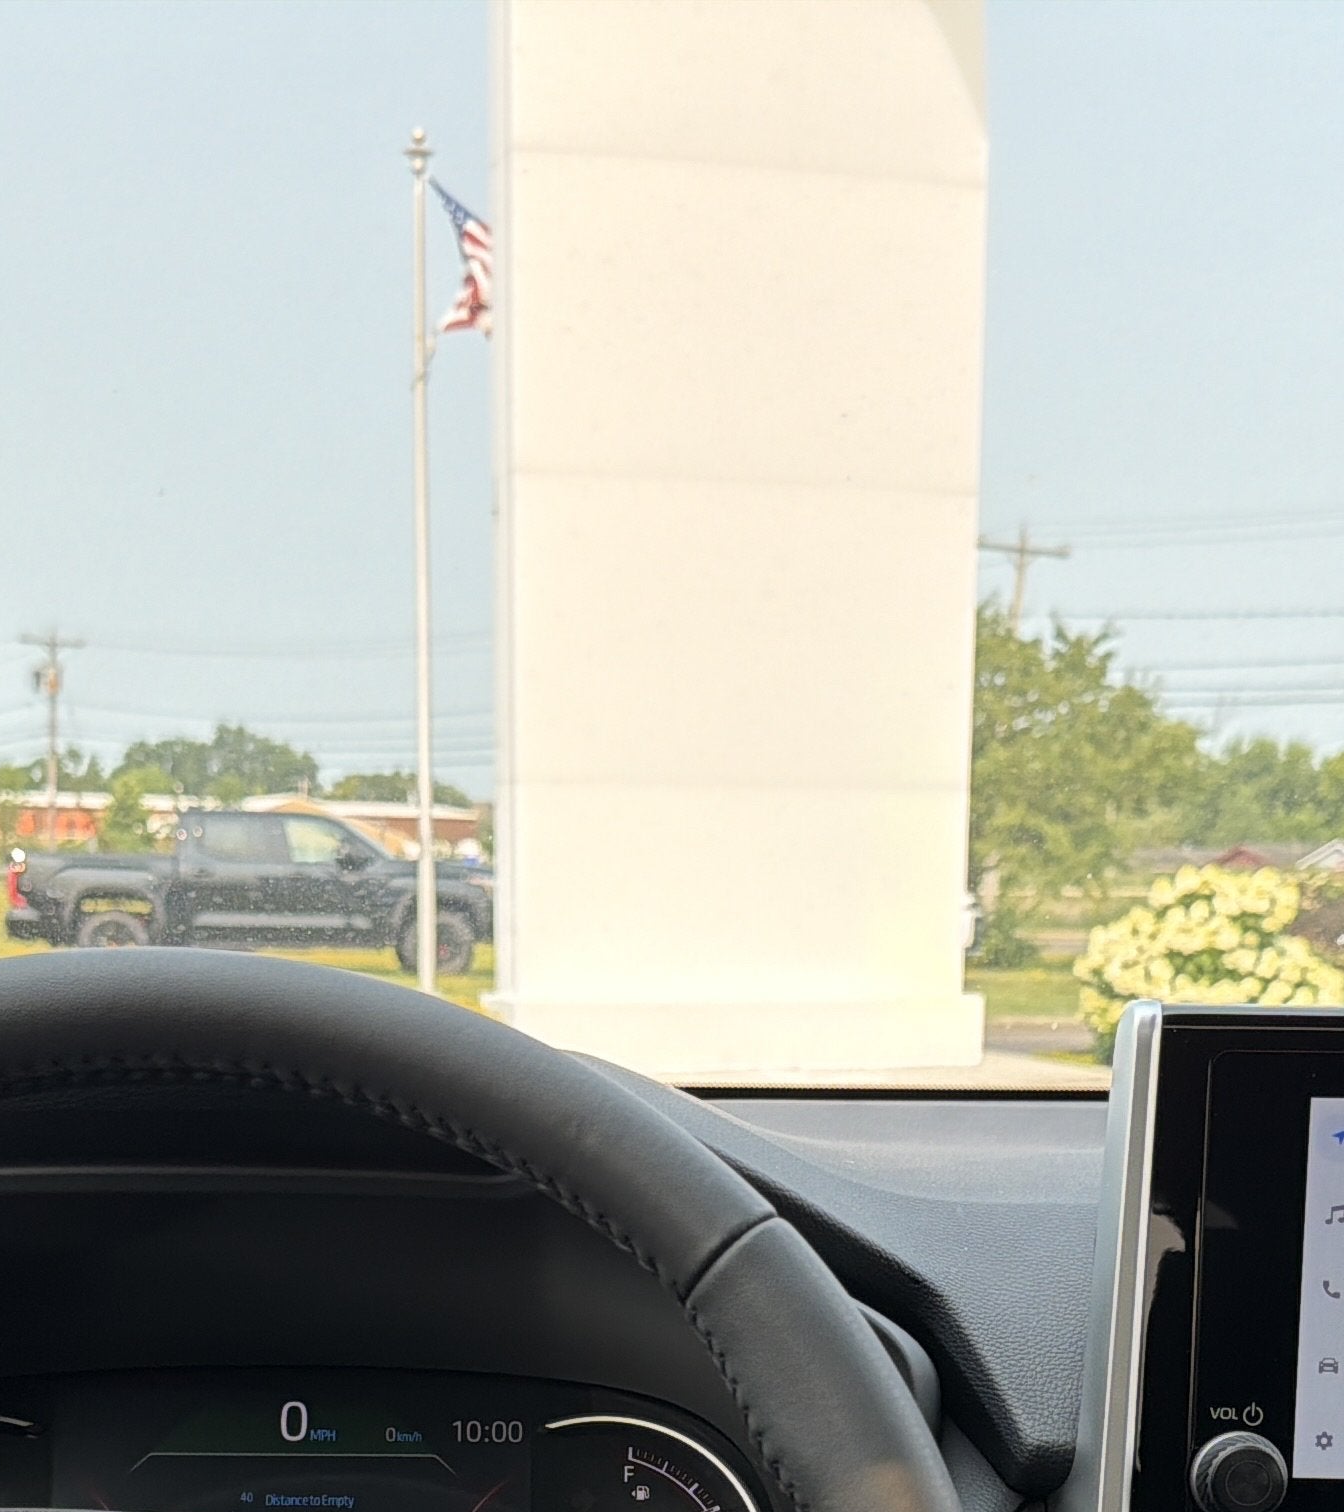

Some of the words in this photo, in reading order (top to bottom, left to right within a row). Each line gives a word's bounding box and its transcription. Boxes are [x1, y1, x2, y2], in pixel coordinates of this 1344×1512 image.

[1210, 1406, 1239, 1420] VOL
[281, 1401, 308, 1431] 0
[310, 1429, 337, 1442] MPH
[385, 1427, 396, 1442] 0
[397, 1431, 423, 1442] km/h
[453, 1419, 524, 1443] 10:00
[623, 1466, 635, 1482] F
[265, 1494, 308, 1506] Distance
[321, 1495, 354, 1509] Empty
